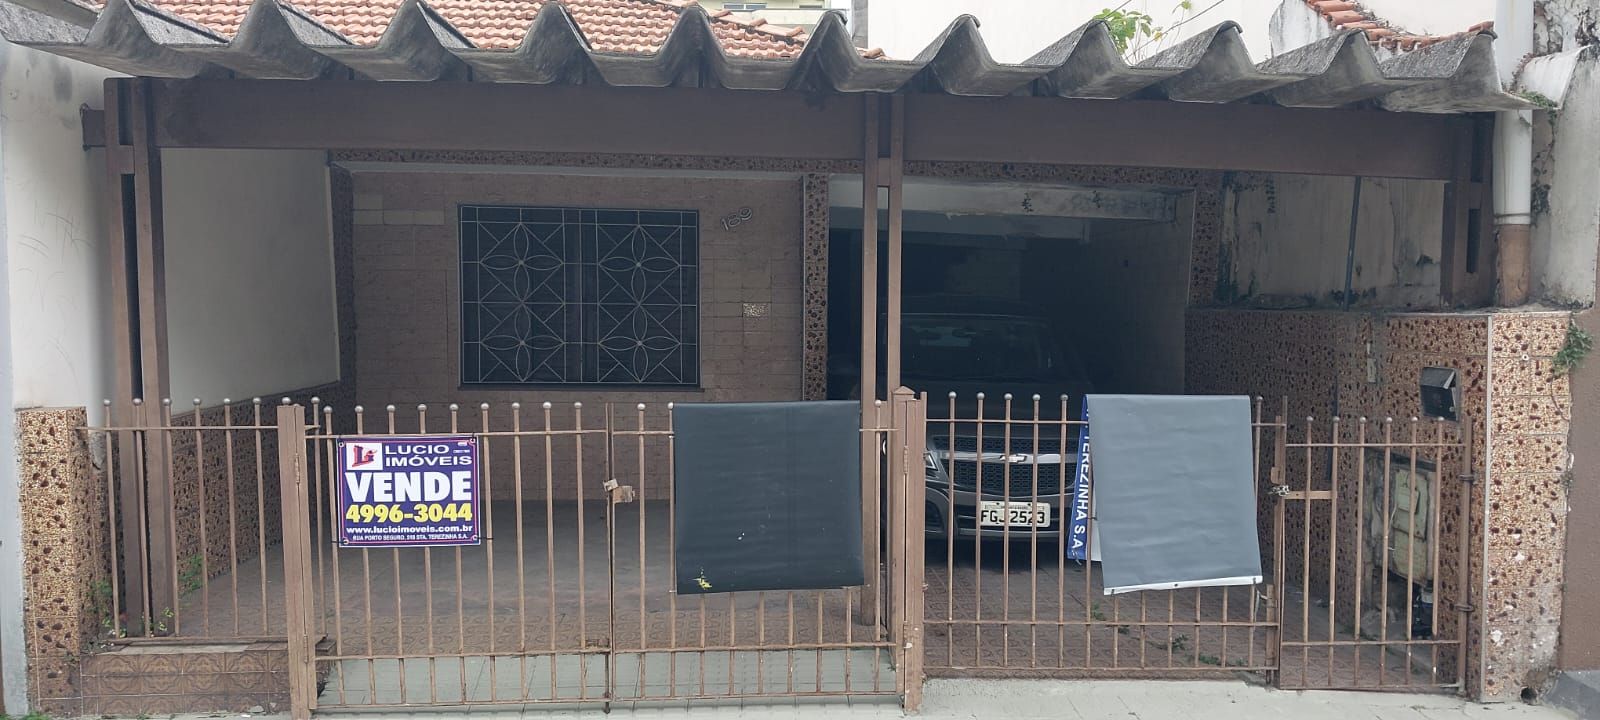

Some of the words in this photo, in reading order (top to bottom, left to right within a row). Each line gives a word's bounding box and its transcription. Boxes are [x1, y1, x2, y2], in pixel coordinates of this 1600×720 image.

[385, 444, 450, 455] LUCIO
[385, 454, 473, 467] IMÓVEIS
[344, 471, 472, 502] VENDE
[345, 503, 473, 523] 4996-3044
[346, 525, 473, 534] www.lucioimoveis.com.br
